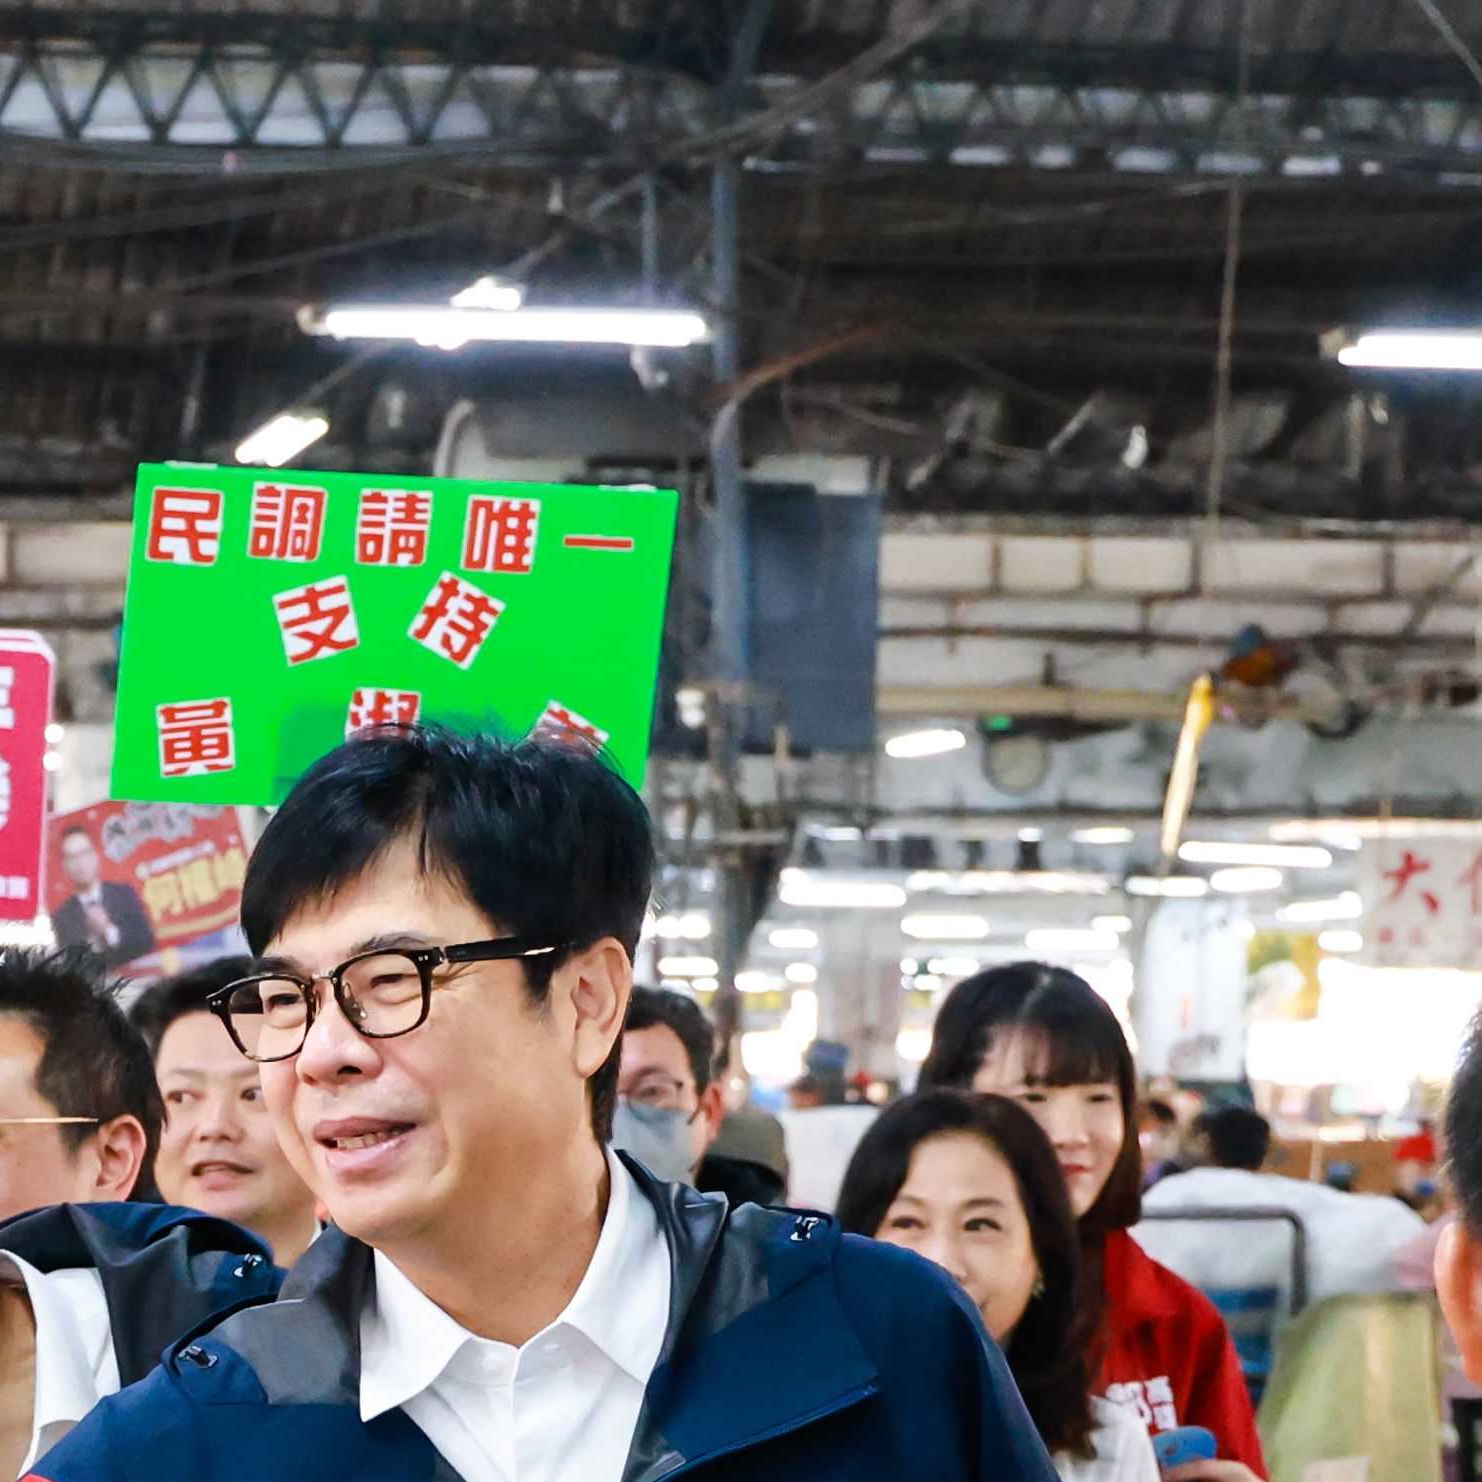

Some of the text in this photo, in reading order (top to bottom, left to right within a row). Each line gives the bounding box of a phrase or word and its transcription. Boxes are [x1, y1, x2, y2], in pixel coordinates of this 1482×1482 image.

[148, 485, 634, 573] 民調請唯一
[275, 573, 499, 666] 支持
